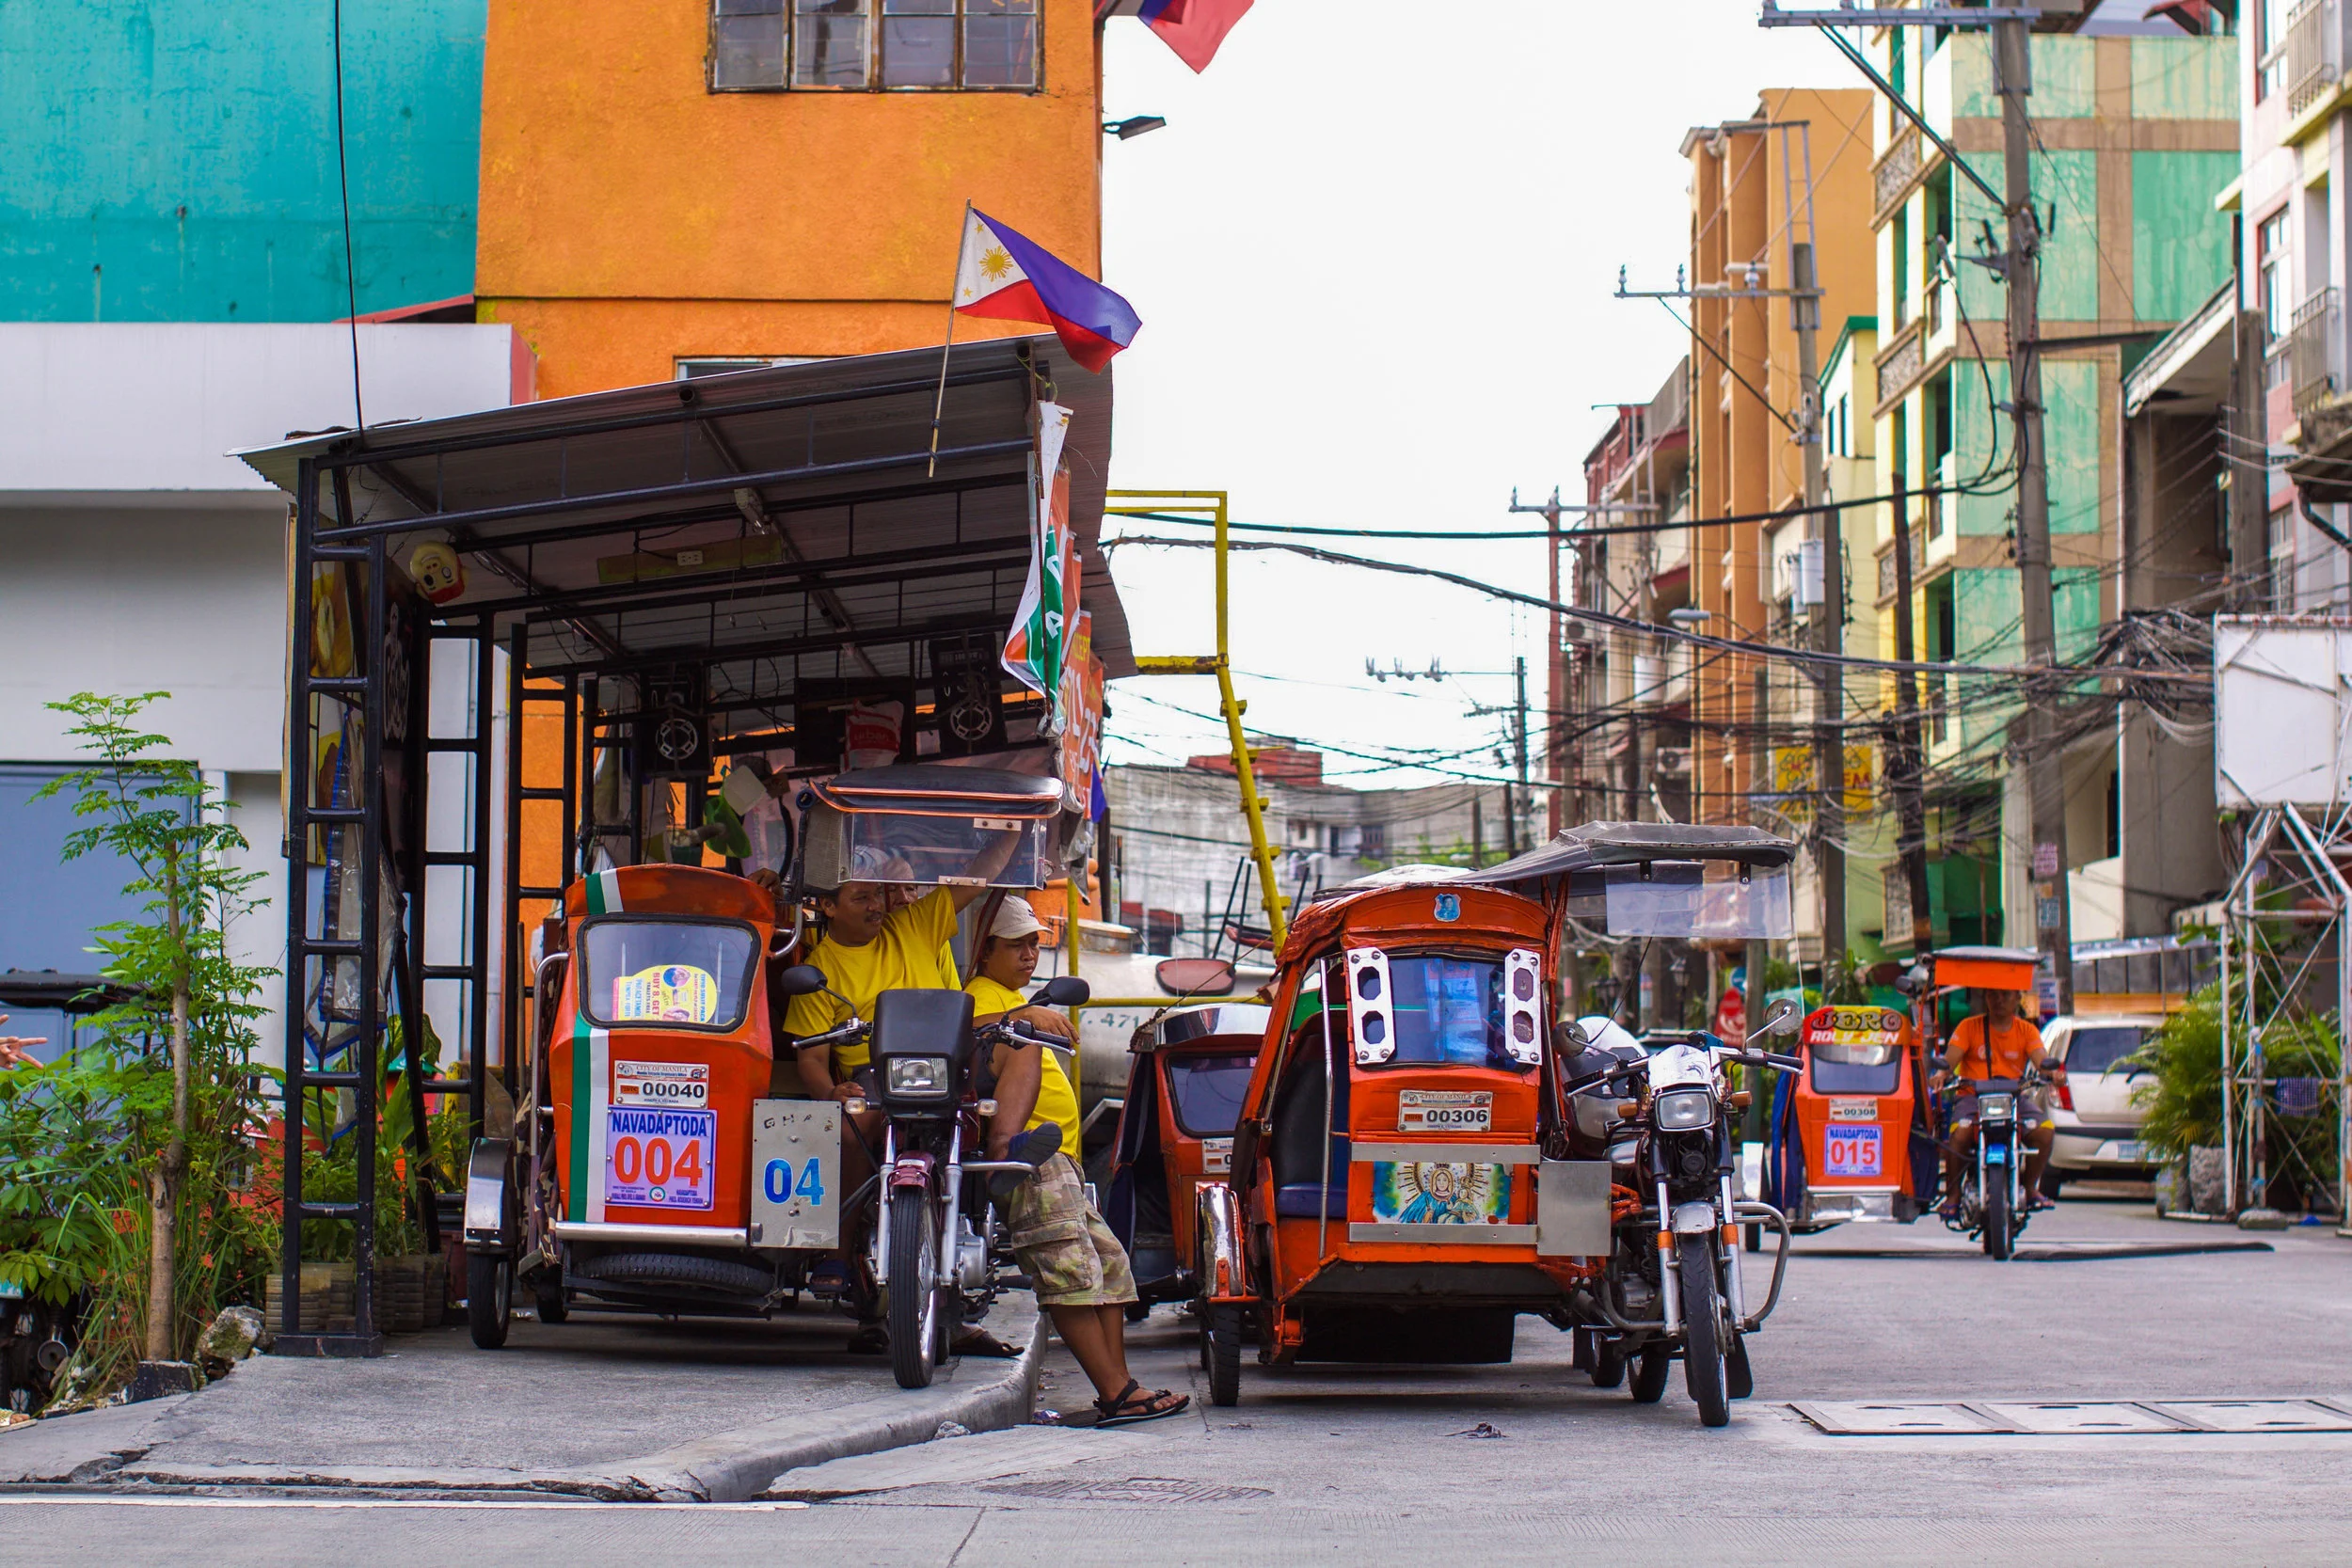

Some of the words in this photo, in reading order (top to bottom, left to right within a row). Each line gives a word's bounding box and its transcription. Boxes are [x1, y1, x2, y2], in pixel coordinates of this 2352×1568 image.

[1810, 1010, 1902, 1032] JERO
[1860, 1032, 1899, 1044] JEN
[643, 1082, 705, 1099] 00040
[612, 1113, 707, 1136] NAVADAPTODA
[1426, 1110, 1487, 1123] 00306
[1830, 1129, 1878, 1139] NAVADAPTODA
[614, 1135, 703, 1188] 004
[1831, 1140, 1876, 1165] 015
[763, 1156, 825, 1207] 04
